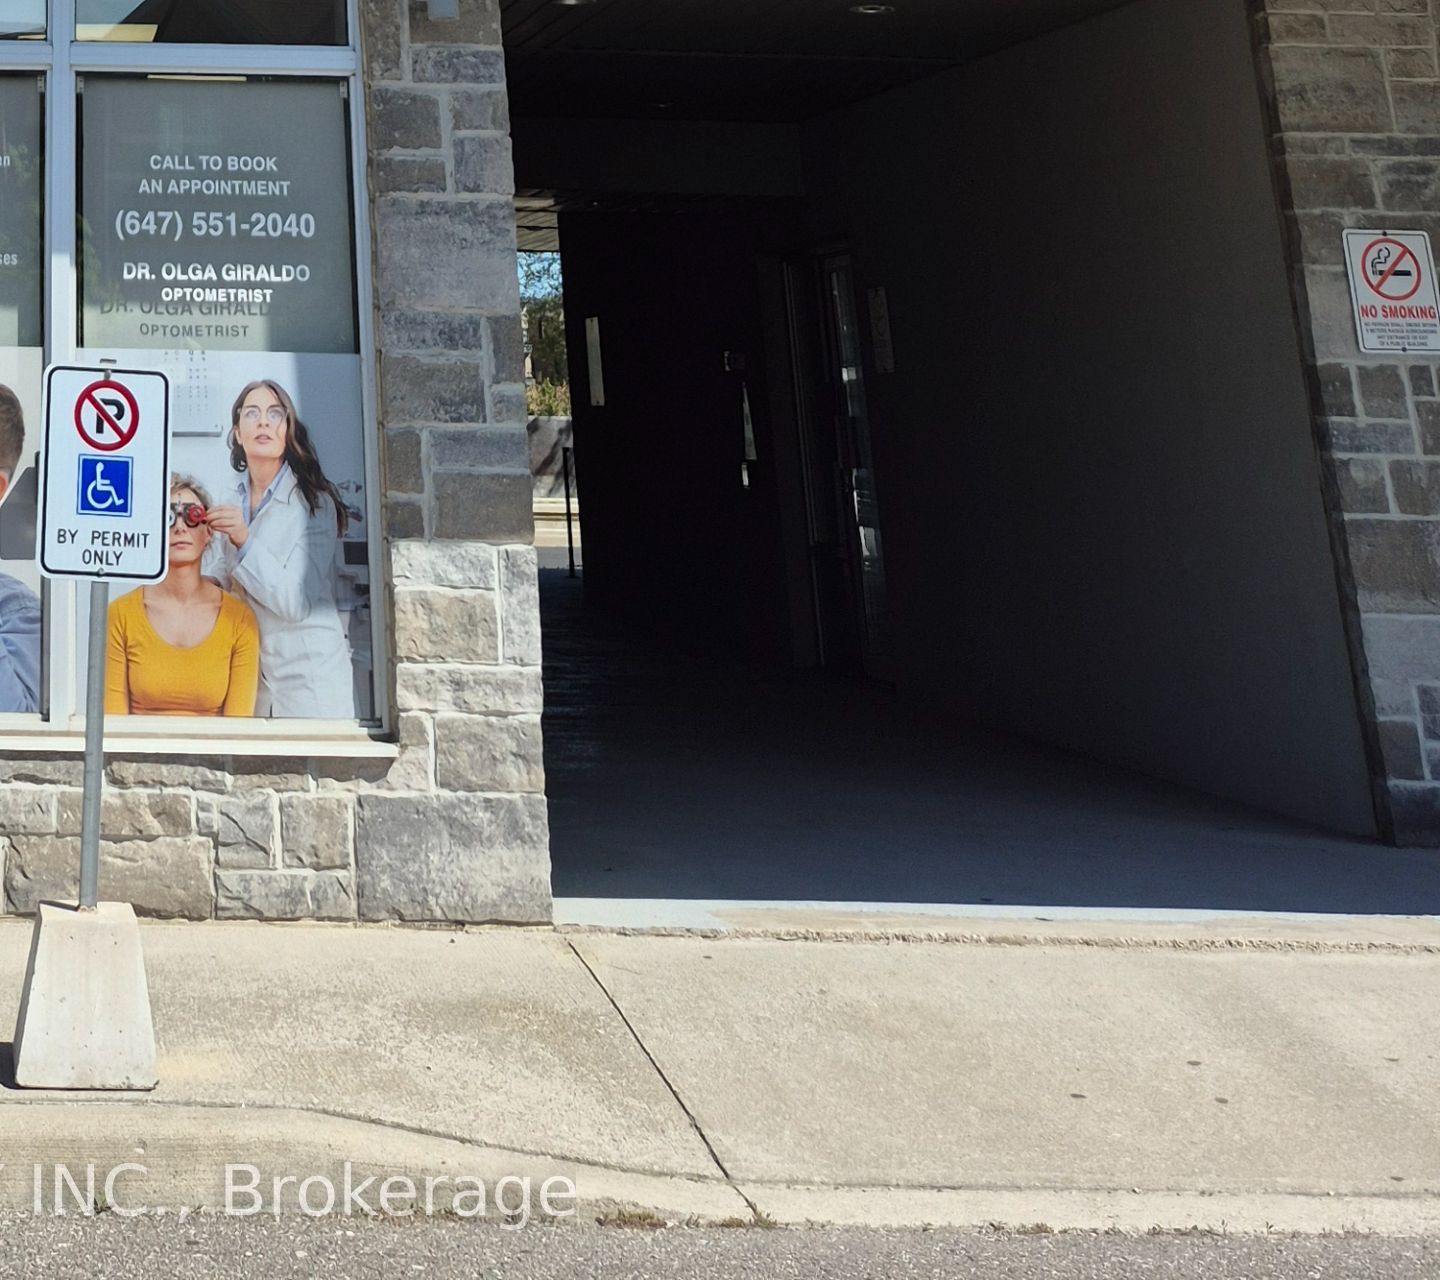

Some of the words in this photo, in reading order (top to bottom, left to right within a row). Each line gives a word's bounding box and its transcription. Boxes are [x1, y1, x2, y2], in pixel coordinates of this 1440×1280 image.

[150, 155, 194, 170] CALL
[199, 155, 222, 170] TO
[227, 156, 278, 171] BOOK
[139, 179, 162, 194] AN
[167, 179, 290, 196] APPOINTMENT
[115, 210, 183, 241] (647)
[192, 212, 315, 237] 551-2040
[123, 262, 156, 279] DR.
[161, 263, 217, 281] OLGA
[221, 264, 310, 282] GIRALDO
[161, 287, 273, 303] OPTOMETRIST
[1360, 304, 1377, 318] NO
[1381, 305, 1437, 319] SMOKING
[57, 528, 78, 544] BY
[91, 530, 150, 548] PERMIT
[82, 549, 123, 566] ONLY
